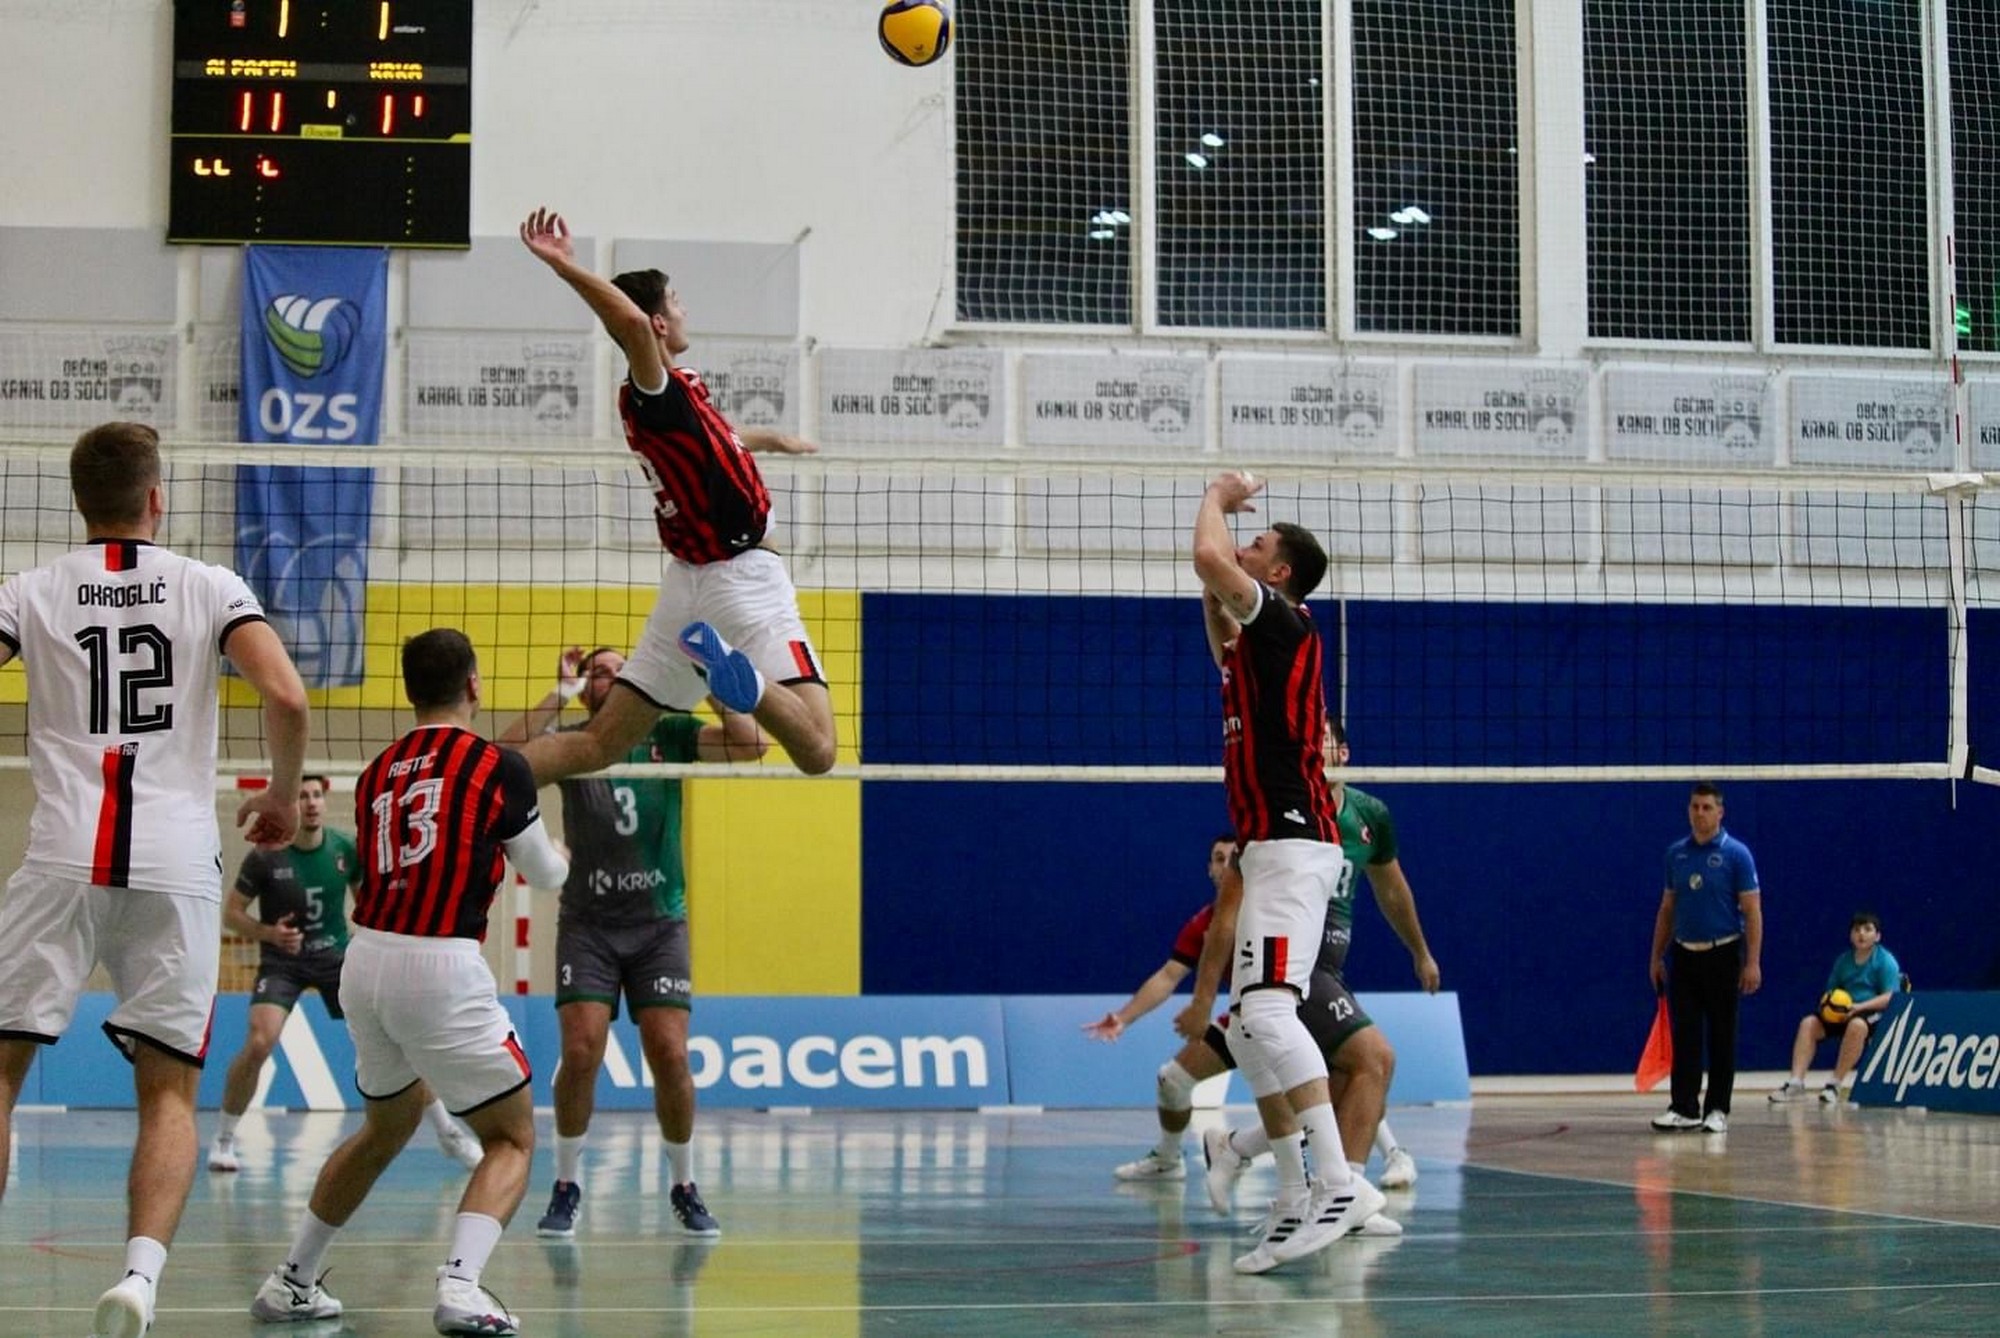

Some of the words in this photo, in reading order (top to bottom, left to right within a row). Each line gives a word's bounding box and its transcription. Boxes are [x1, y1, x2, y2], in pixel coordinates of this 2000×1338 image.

[260, 388, 357, 440] OZS
[1801, 420, 1842, 439] KANAL
[1846, 422, 1863, 441] OB
[78, 576, 166, 608] OKROGLIČ
[74, 624, 173, 734] 12
[371, 778, 444, 875] 13
[614, 786, 639, 836] 3
[617, 869, 667, 892] KRKA
[305, 887, 324, 921] 5
[562, 964, 572, 986] 3
[1328, 997, 1354, 1022] 23
[1861, 998, 2000, 1102] Alpace
